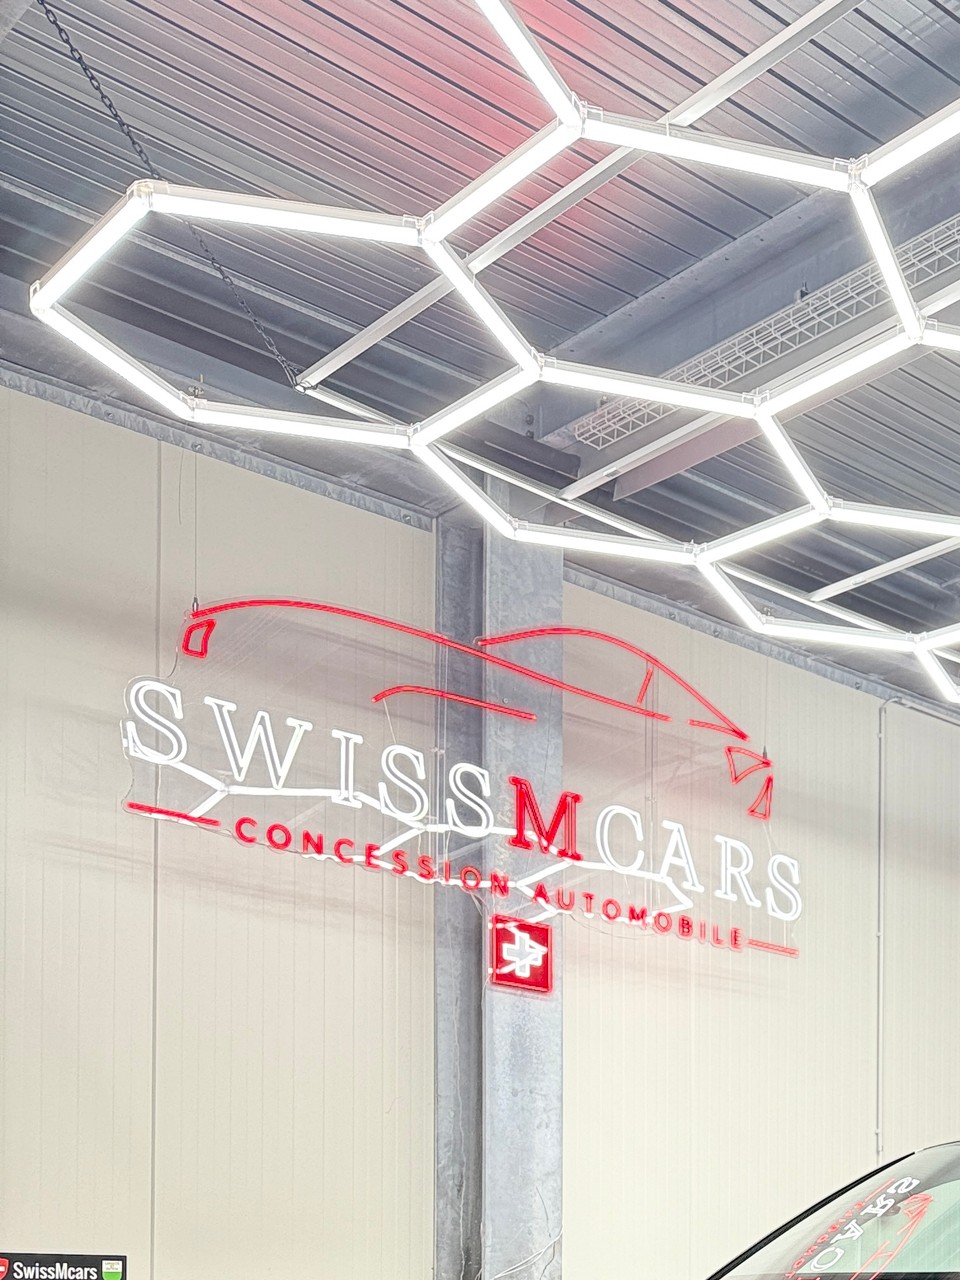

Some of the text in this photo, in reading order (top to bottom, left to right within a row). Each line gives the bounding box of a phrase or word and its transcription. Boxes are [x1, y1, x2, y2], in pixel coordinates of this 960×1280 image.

[234, 815, 744, 952] CONCESSION AUTOMOBILE
[12, 1261, 98, 1280] SwissMcars
